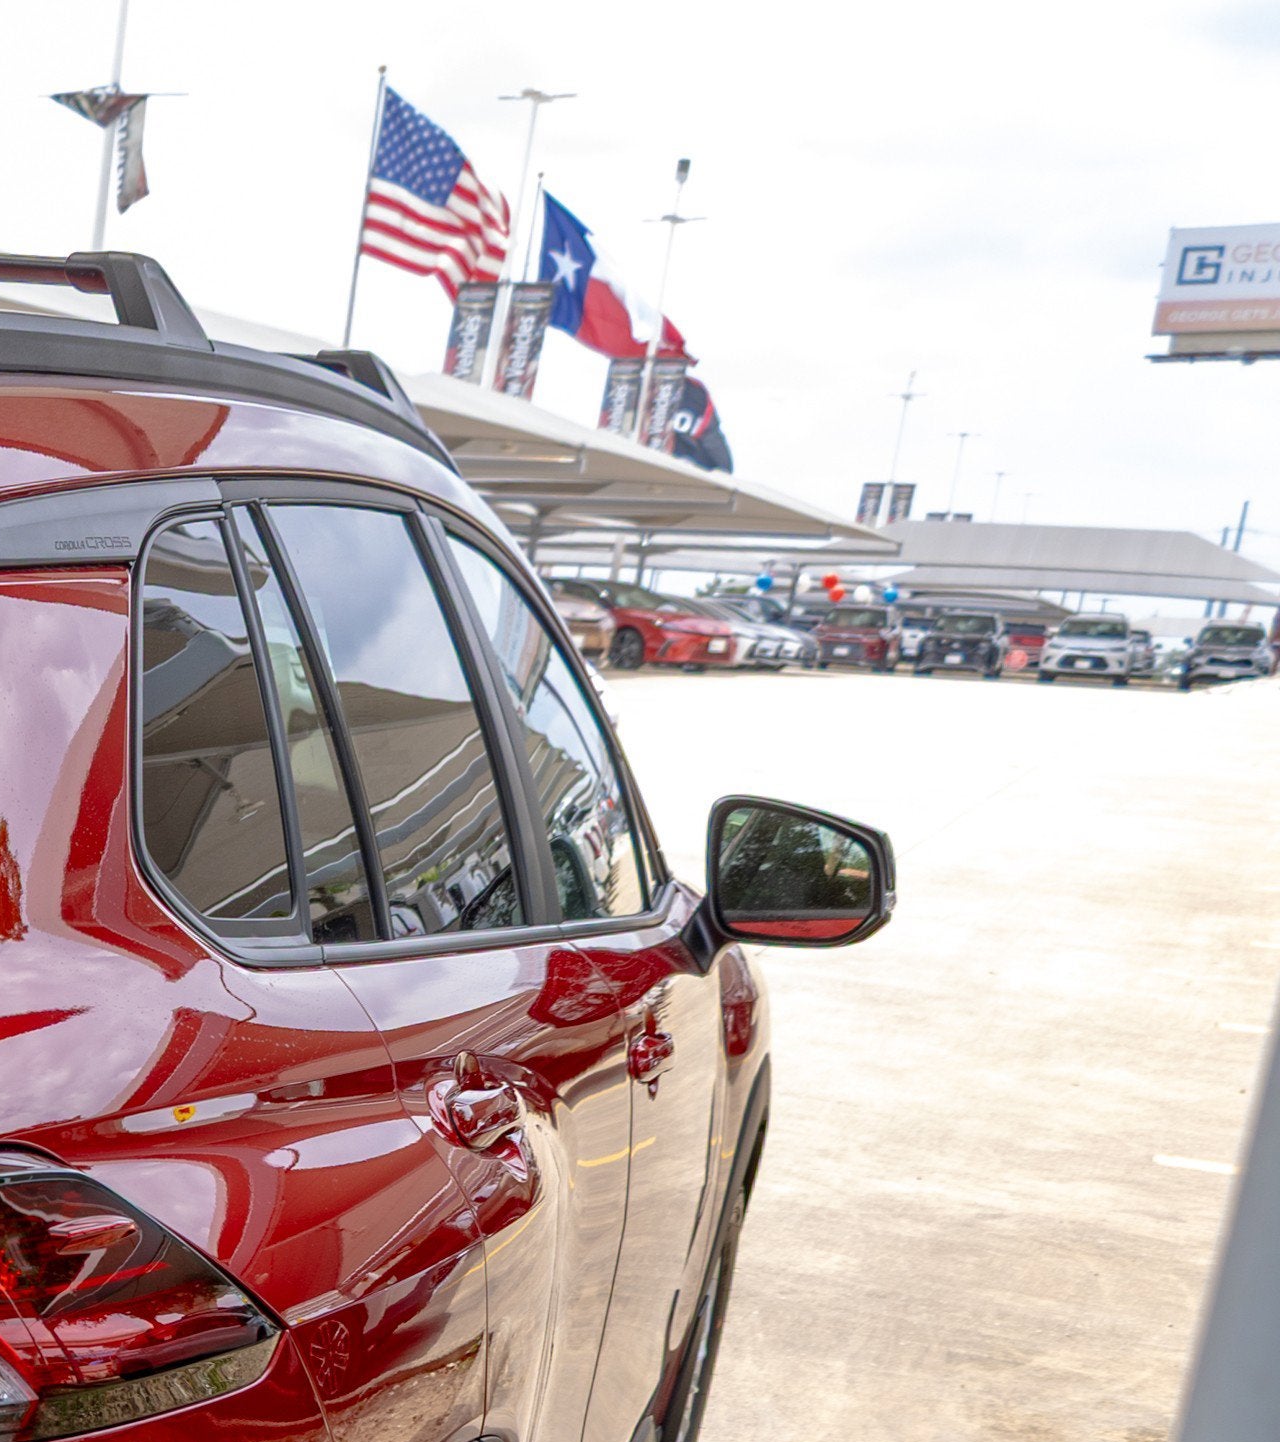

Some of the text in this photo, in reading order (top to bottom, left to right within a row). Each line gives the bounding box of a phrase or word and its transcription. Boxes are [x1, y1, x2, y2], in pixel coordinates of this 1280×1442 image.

[1227, 268, 1280, 284] INJ
[504, 315, 535, 379] Vehicles
[54, 536, 132, 551] COROLLA CROSS
